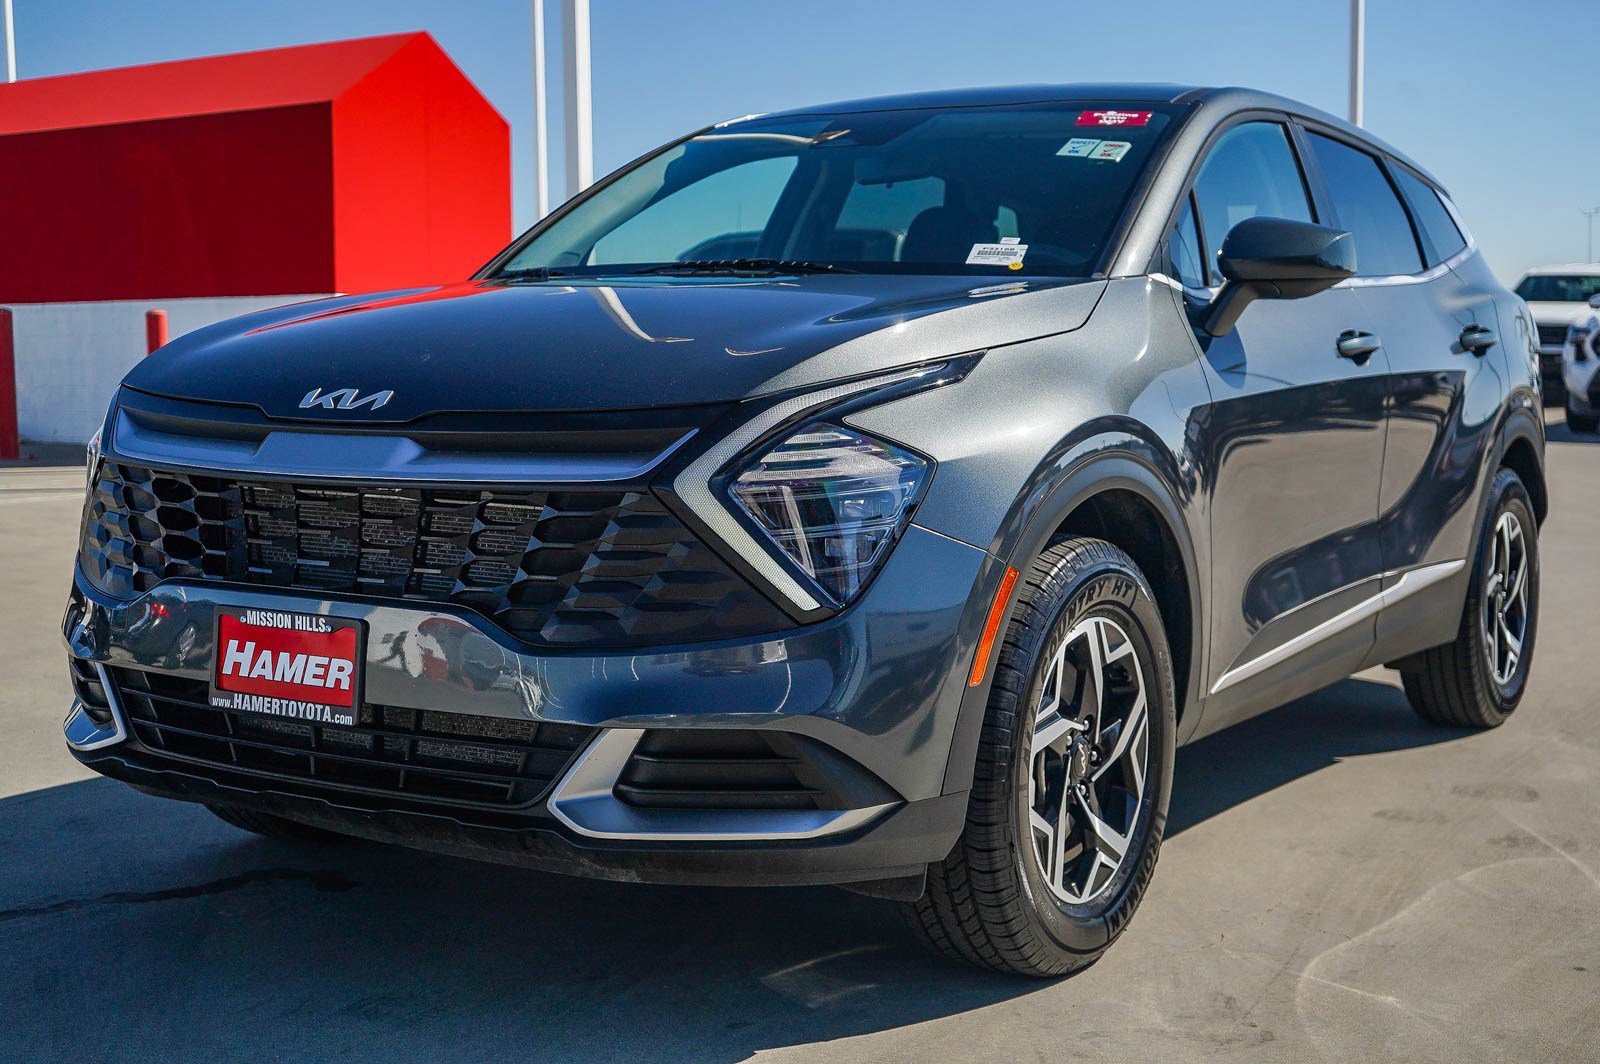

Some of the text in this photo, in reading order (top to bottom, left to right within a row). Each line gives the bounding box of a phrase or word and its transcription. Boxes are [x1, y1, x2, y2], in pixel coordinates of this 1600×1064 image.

[1111, 579, 1133, 598] HT
[246, 610, 326, 633] MISSION HILLS
[221, 639, 354, 691] HAMER
[212, 693, 353, 726] www.HAMERTOYOTA.com
[1110, 823, 1164, 932] IRONMAN
